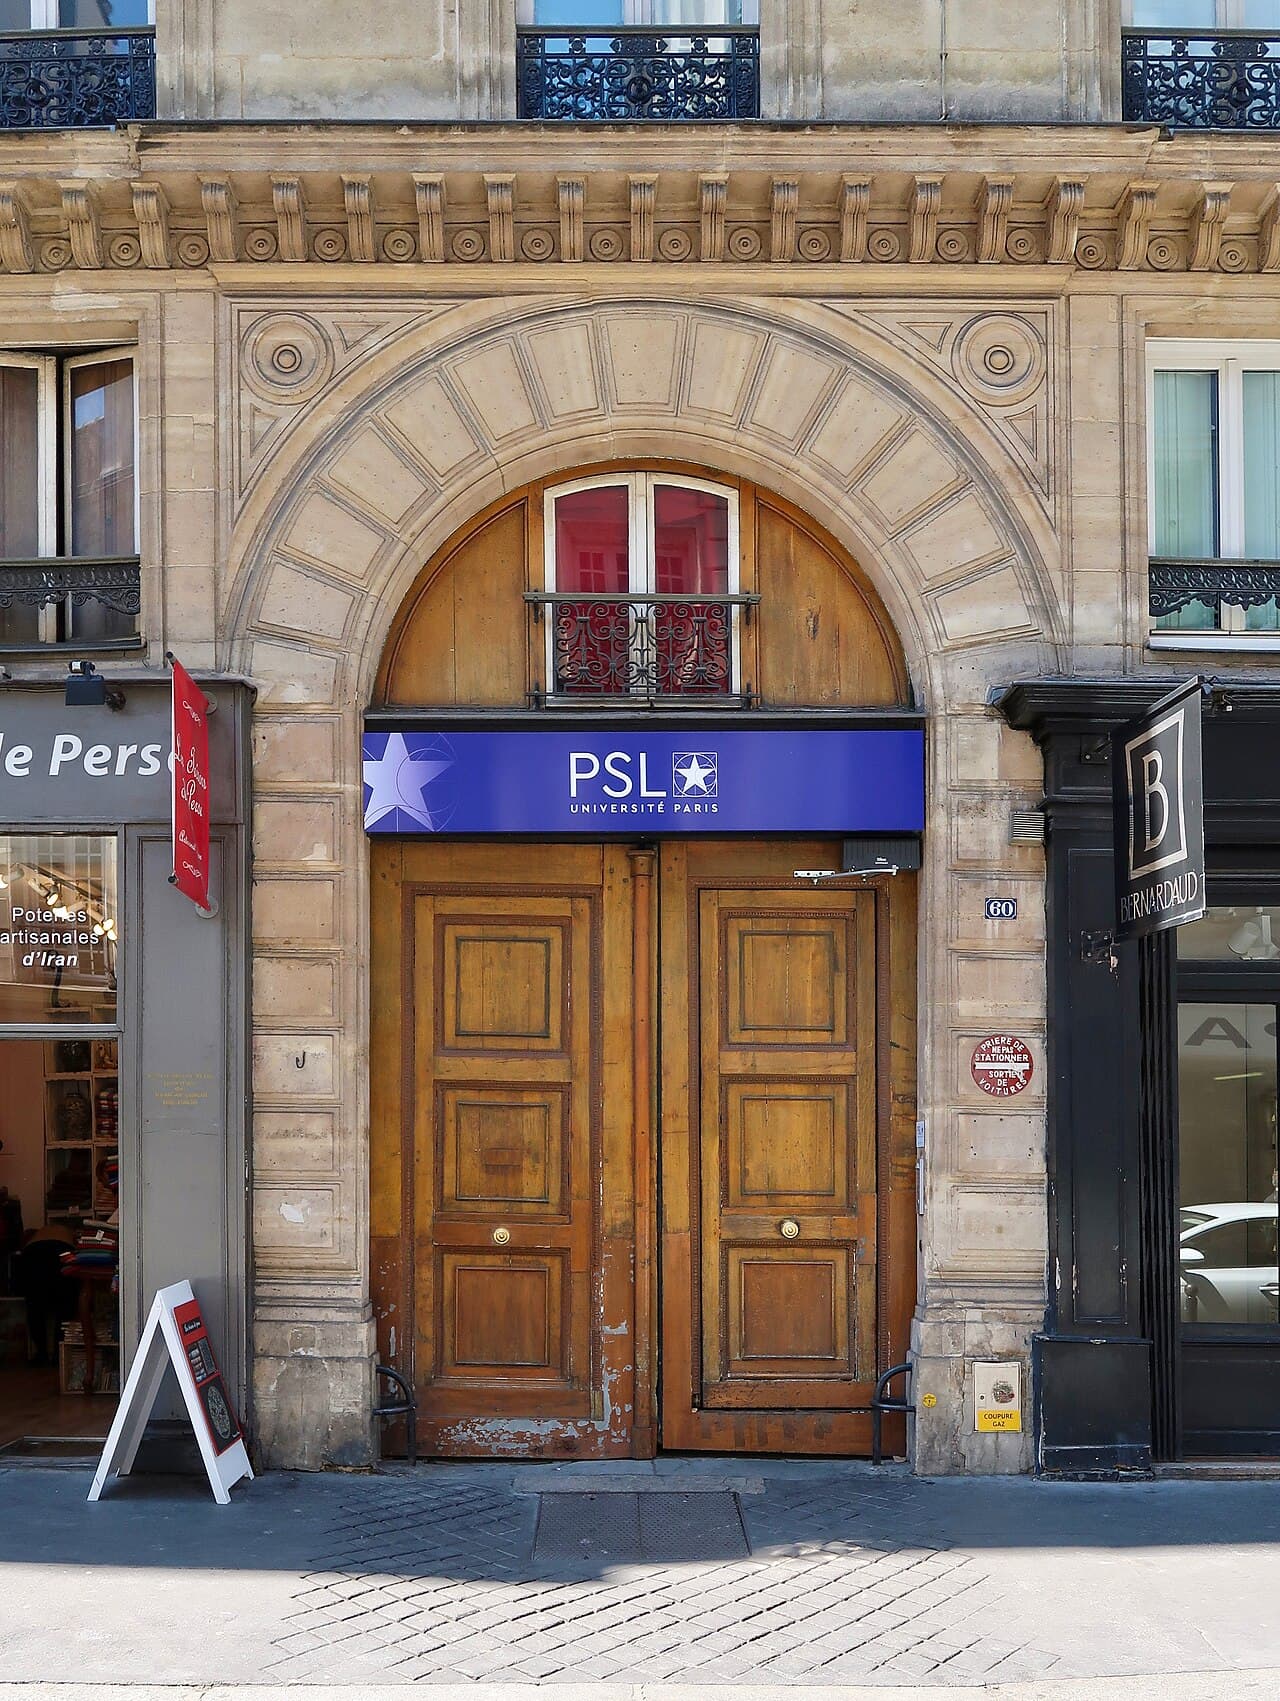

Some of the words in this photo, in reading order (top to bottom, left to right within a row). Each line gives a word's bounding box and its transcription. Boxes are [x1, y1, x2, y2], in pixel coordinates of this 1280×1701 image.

[0, 733, 33, 777] e
[569, 751, 667, 798] PSL
[570, 801, 665, 813] UNIVERSITÉ
[673, 803, 719, 813] PARIS
[1142, 749, 1169, 852] B
[1120, 871, 1198, 923] BERNARDAUD
[990, 901, 1014, 917] 60
[0, 929, 99, 944] artisanales
[22, 951, 78, 967] d'Iran
[980, 1036, 1012, 1051] PRIERE
[1013, 1040, 1025, 1052] DE
[975, 1053, 1029, 1062] STATIONNER
[979, 1078, 1027, 1095] VOITURES
[997, 1078, 1008, 1087] DE
